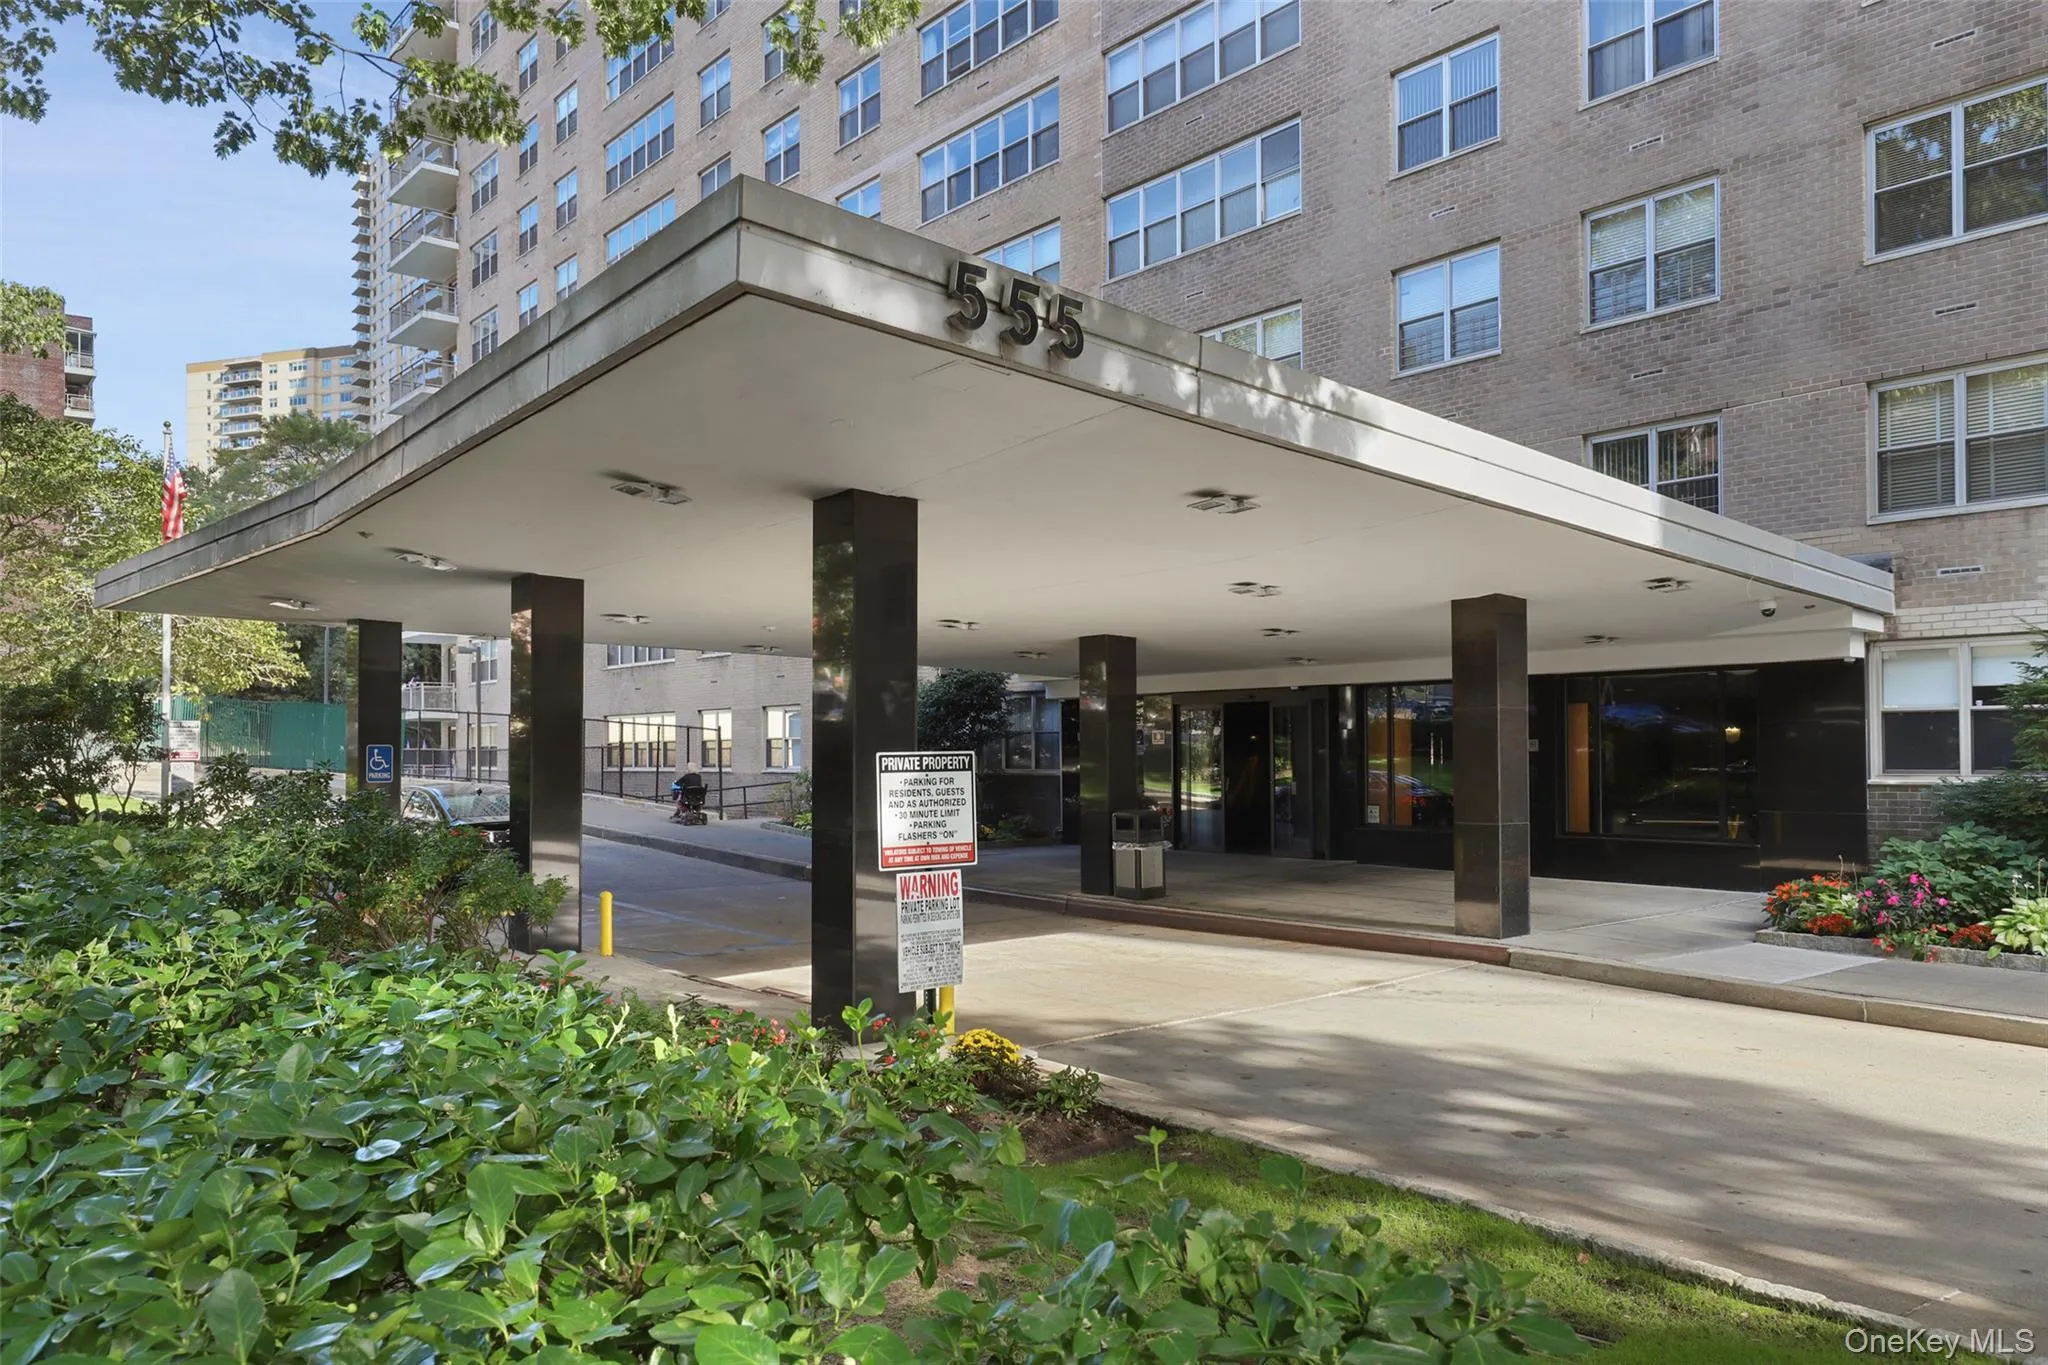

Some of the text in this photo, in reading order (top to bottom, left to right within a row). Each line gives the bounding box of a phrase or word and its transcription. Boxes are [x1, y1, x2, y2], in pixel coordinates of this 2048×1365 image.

[948, 261, 1084, 359] 555
[881, 755, 970, 771] PRIVATE PROPERTY
[904, 777, 955, 787] PARKING FOR
[935, 787, 965, 797] GUESTS
[888, 798, 967, 809] AND AS AUTHORIZED
[899, 808, 960, 819] 30 MINUTE LIMIT
[913, 820, 947, 829] PARKING
[898, 831, 937, 841] FLASHERS
[900, 872, 959, 900] WARNING
[901, 897, 960, 913] PRIVATE PARKING LOT
